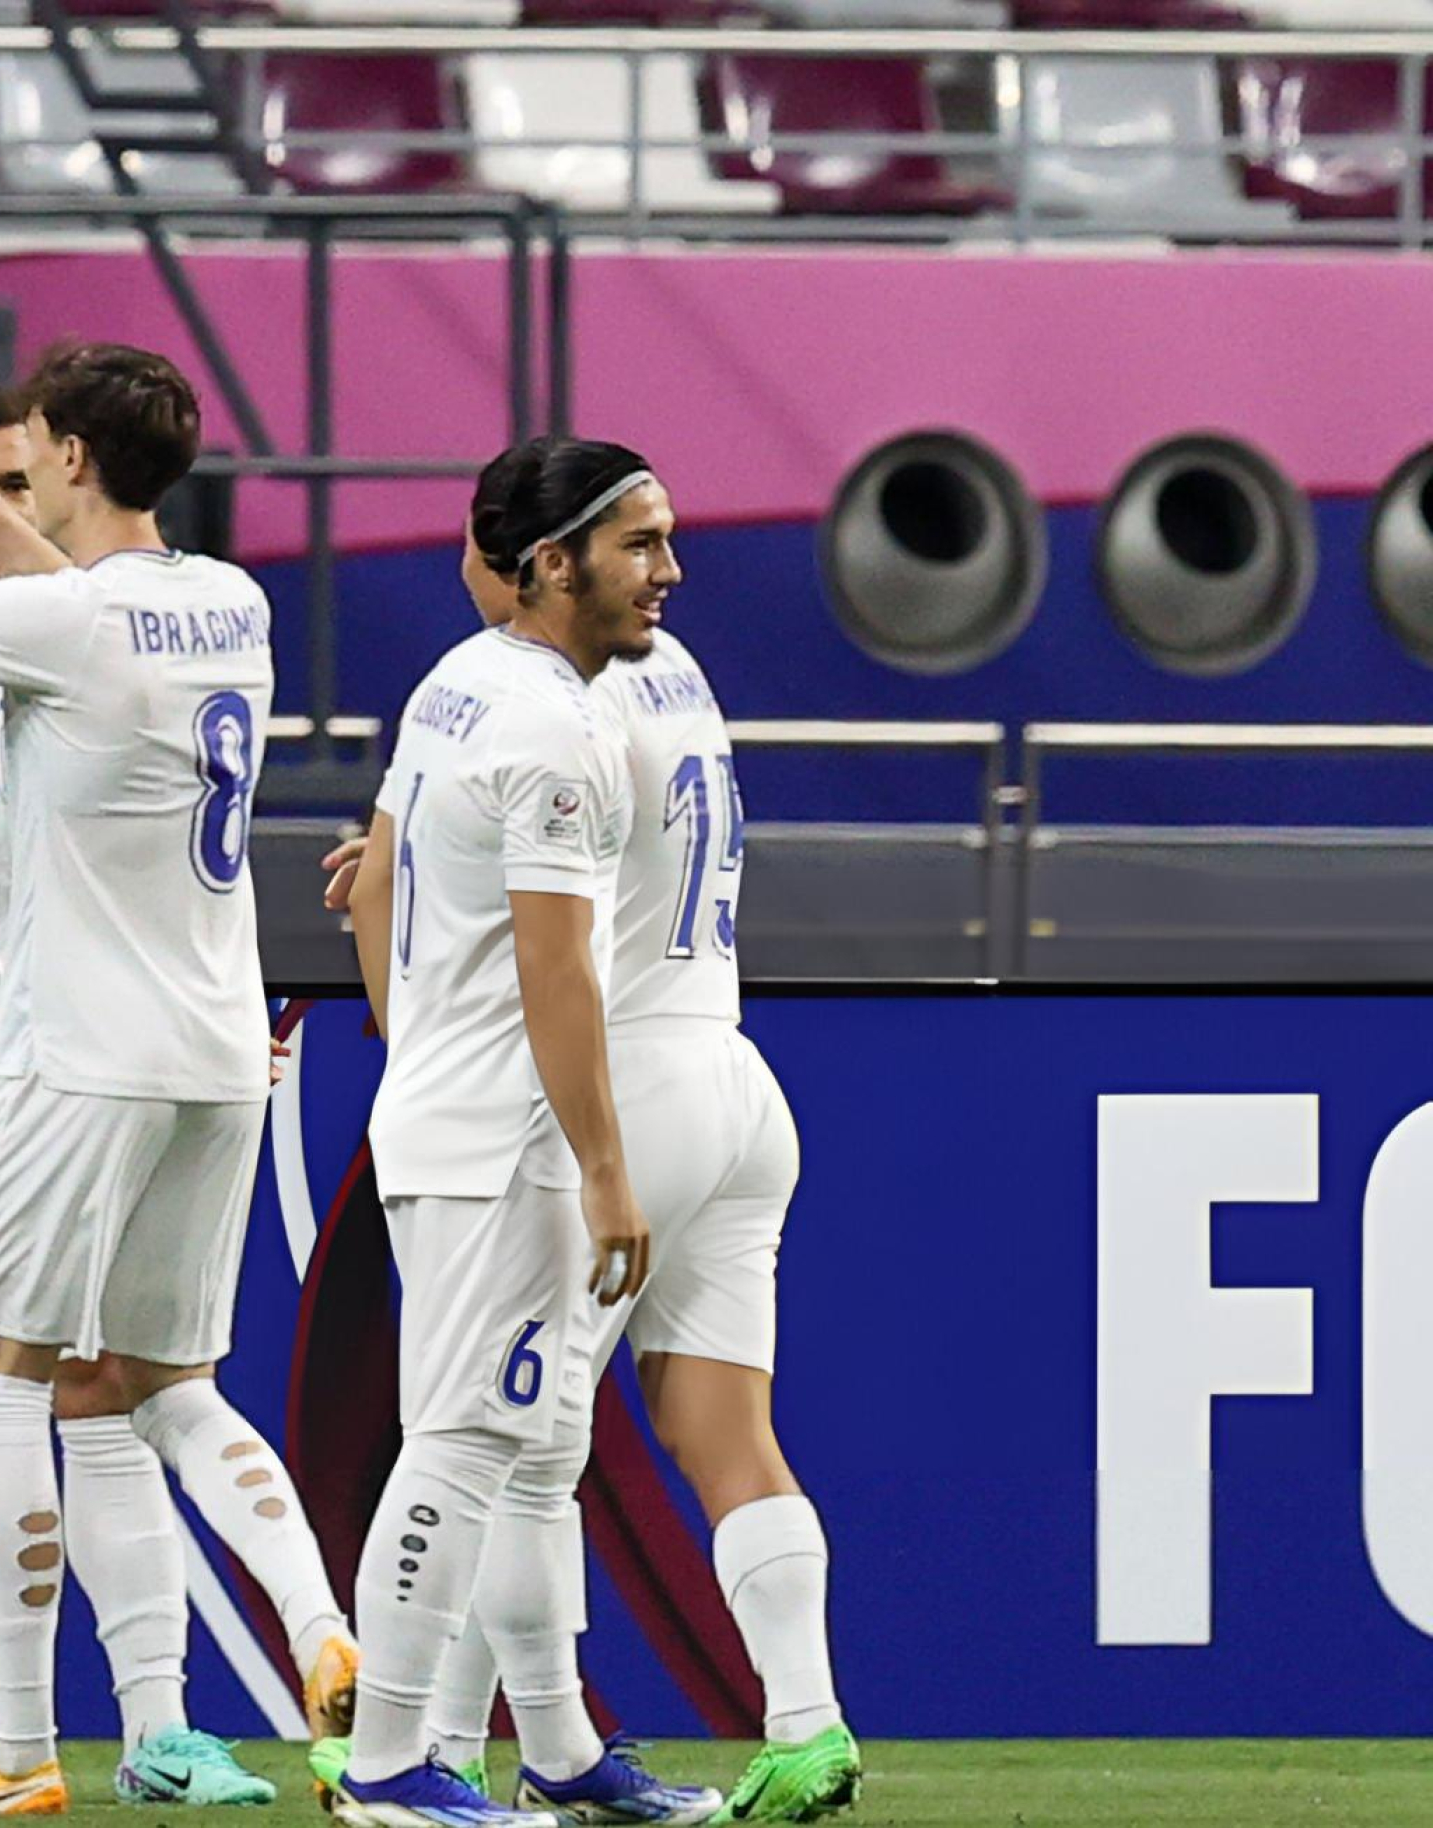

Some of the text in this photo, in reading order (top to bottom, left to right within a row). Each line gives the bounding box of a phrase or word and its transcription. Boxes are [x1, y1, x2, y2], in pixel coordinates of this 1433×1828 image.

[189, 690, 253, 894] 8
[663, 755, 744, 960] 15
[496, 1319, 545, 1410] 6
[1097, 1093, 1433, 1646] F
